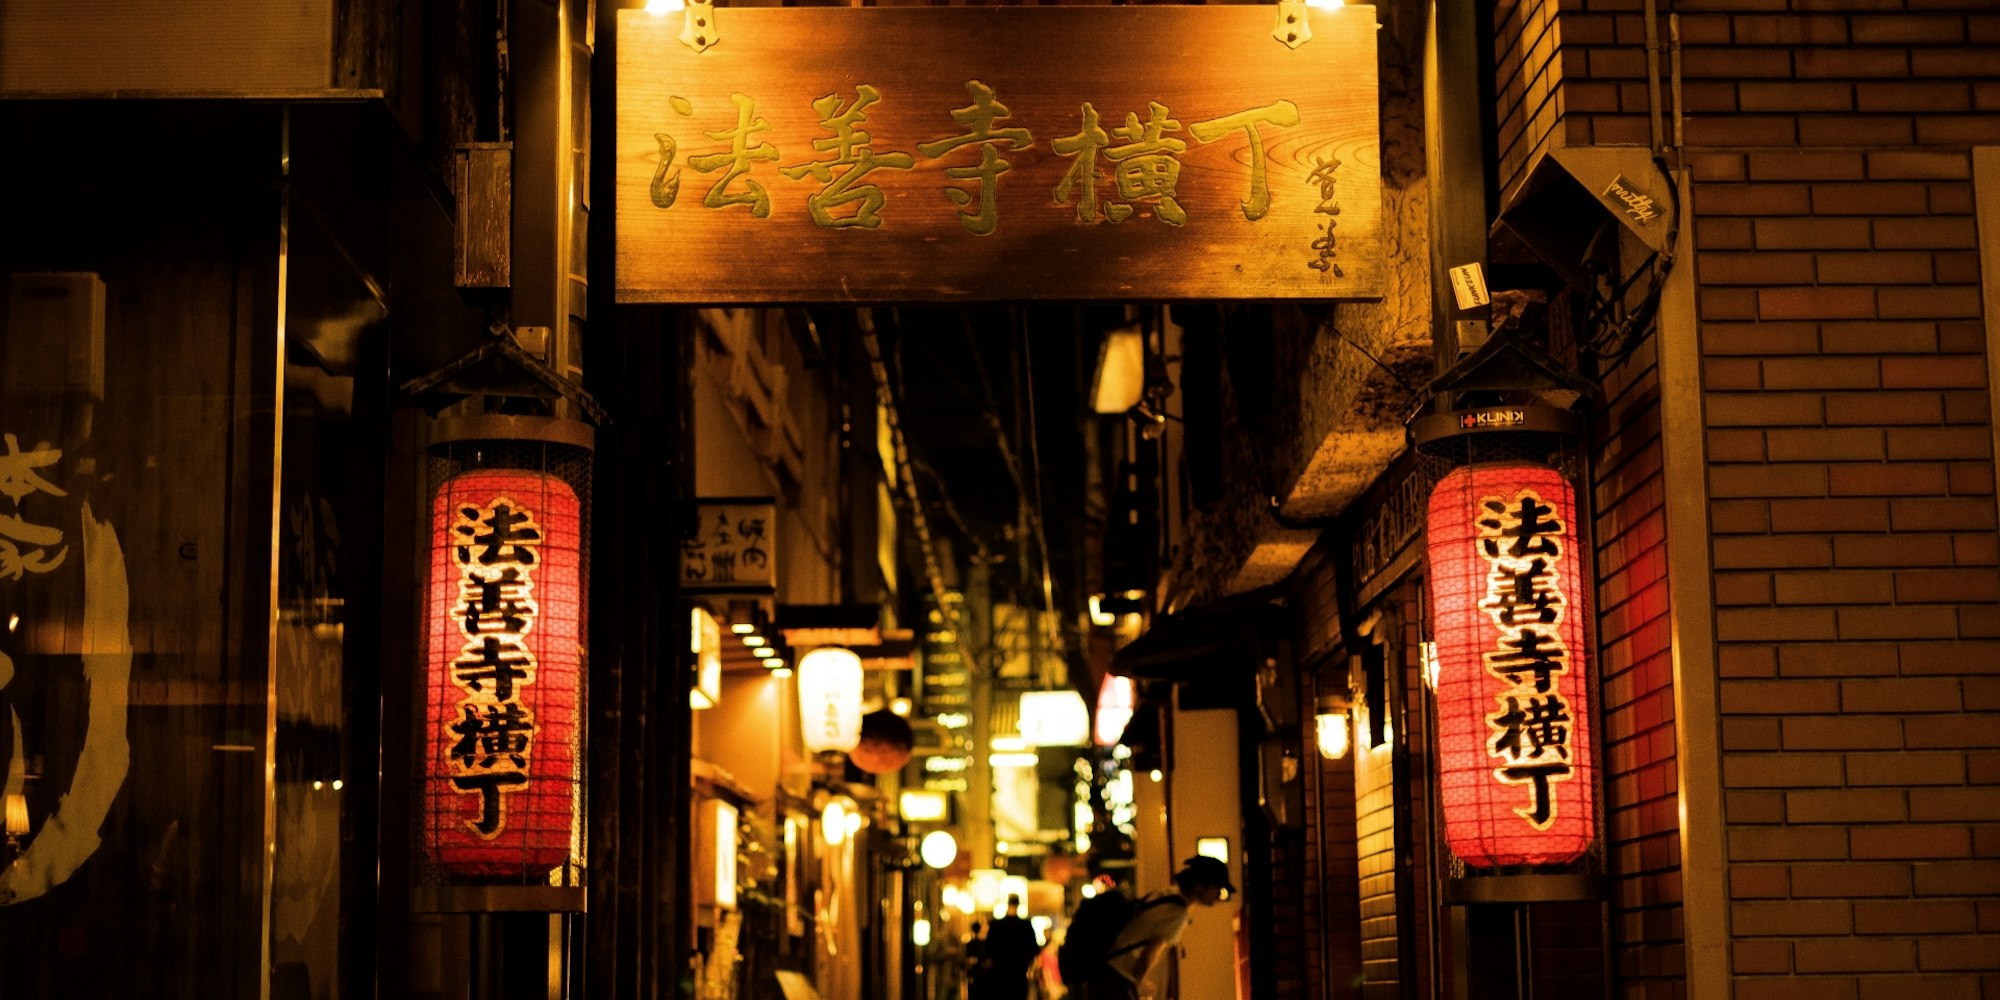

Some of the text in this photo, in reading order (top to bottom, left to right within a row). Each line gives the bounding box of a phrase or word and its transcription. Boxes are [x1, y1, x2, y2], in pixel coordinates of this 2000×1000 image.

[650, 80, 1300, 236] 法善寺横丁
[450, 500, 542, 838] 法善寺横丁
[1480, 497, 1574, 826] 法善寺横丁
